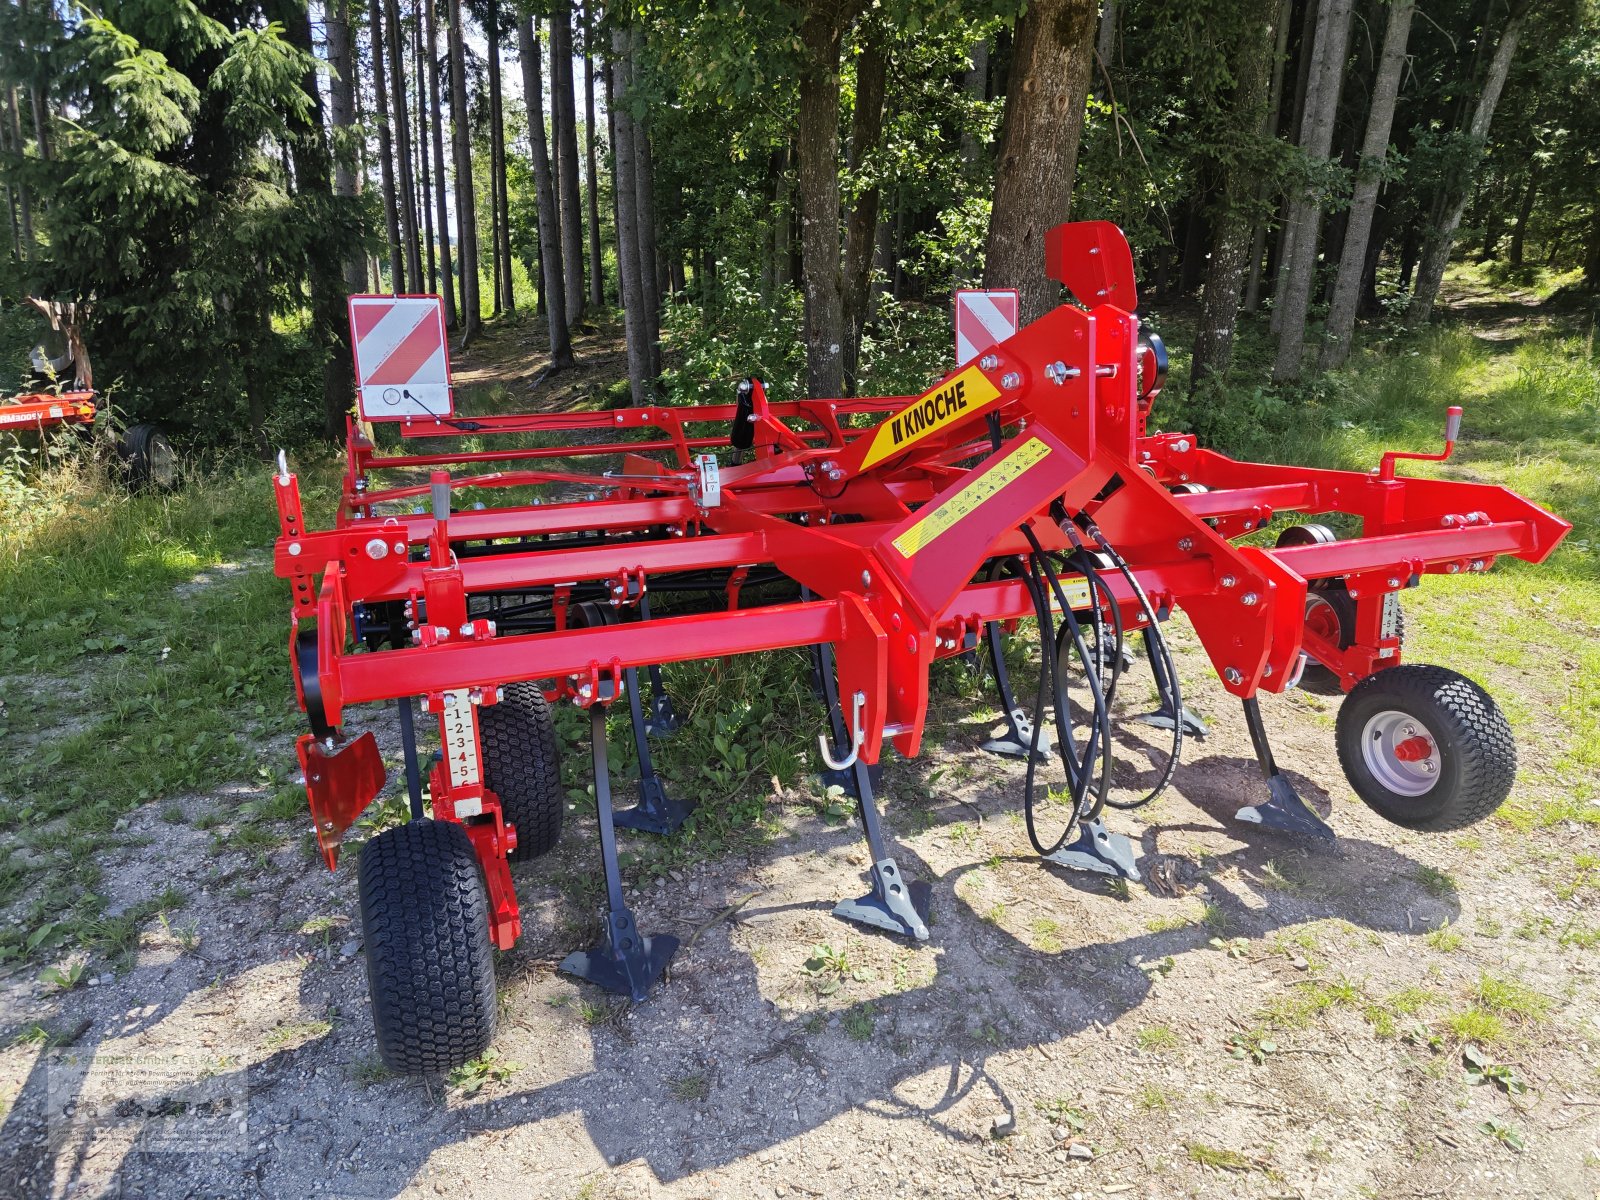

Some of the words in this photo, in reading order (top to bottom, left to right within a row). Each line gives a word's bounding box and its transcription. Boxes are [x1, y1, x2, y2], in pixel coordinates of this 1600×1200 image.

[903, 380, 968, 439] KNOCHE
[455, 708, 462, 720] 1
[455, 723, 464, 734] 2
[456, 737, 465, 748] 3
[458, 752, 467, 762] 4
[460, 765, 468, 777] 5
